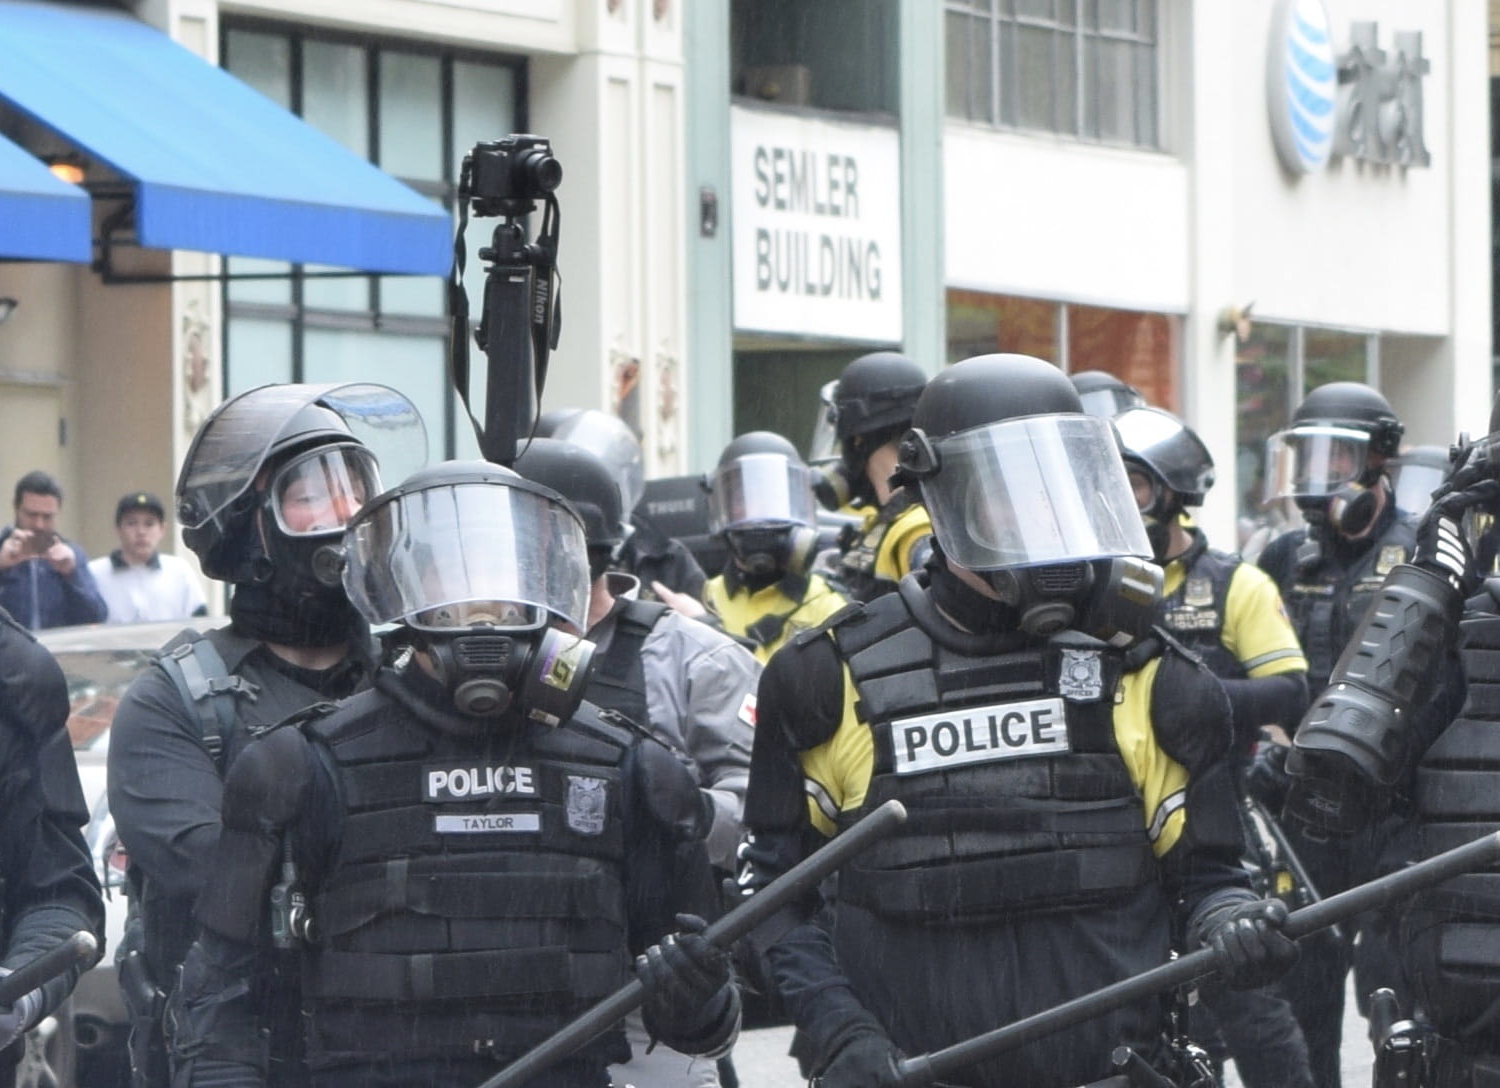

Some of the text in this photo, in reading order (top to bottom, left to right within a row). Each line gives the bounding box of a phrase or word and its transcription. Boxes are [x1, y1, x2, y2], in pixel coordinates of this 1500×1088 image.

[754, 145, 861, 220] SEMLER
[755, 226, 883, 302] BUILDING
[534, 278, 549, 325] Nikon
[904, 708, 1058, 762] POLICE
[428, 765, 536, 798] POLICE
[462, 817, 515, 830] TAYLOR
